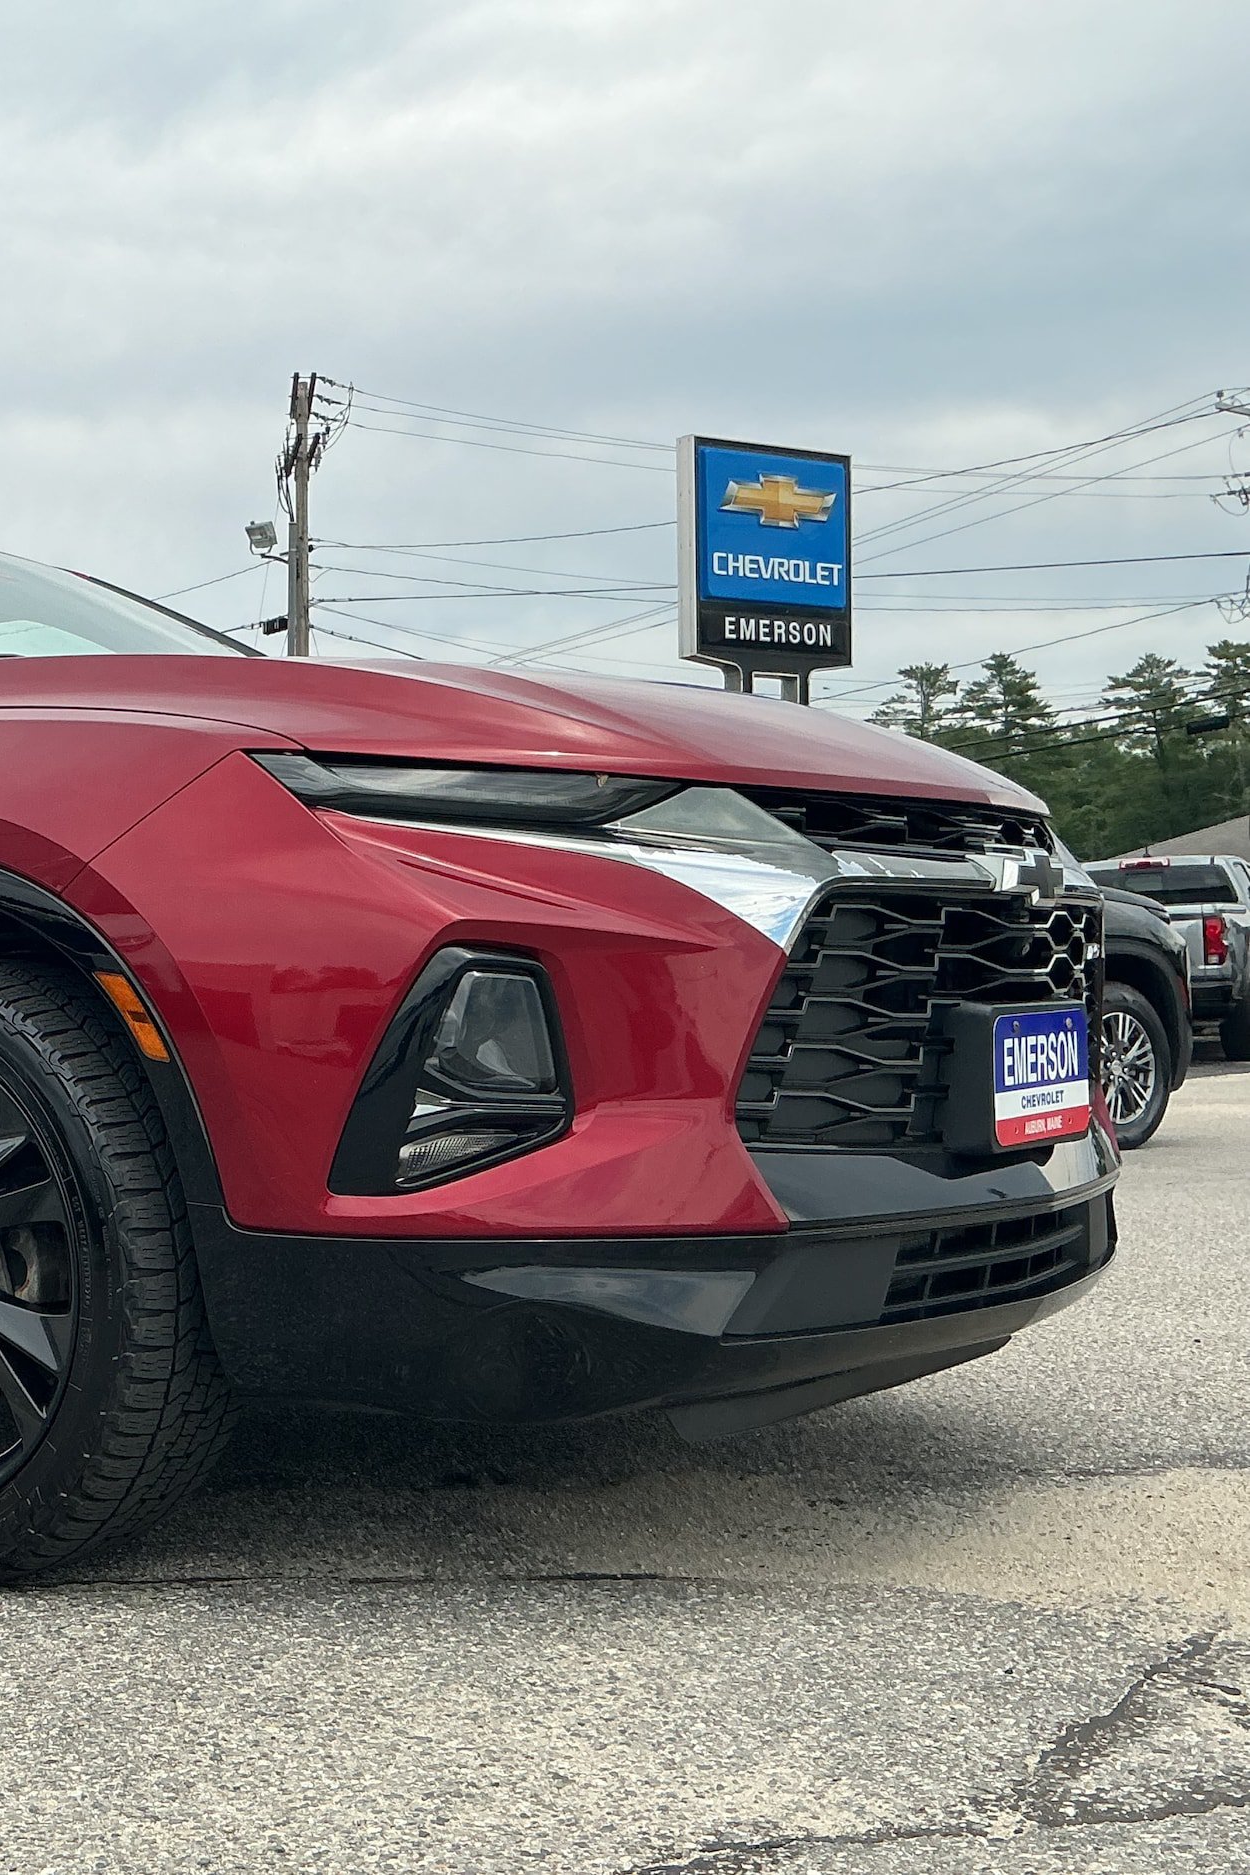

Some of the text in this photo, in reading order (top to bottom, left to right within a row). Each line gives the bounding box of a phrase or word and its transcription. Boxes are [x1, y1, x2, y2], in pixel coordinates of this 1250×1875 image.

[712, 551, 843, 586] CHEVROLET
[724, 616, 832, 647] EMERSON
[1003, 1031, 1079, 1086] EMERSON
[1021, 1089, 1064, 1109] CHEVROLET
